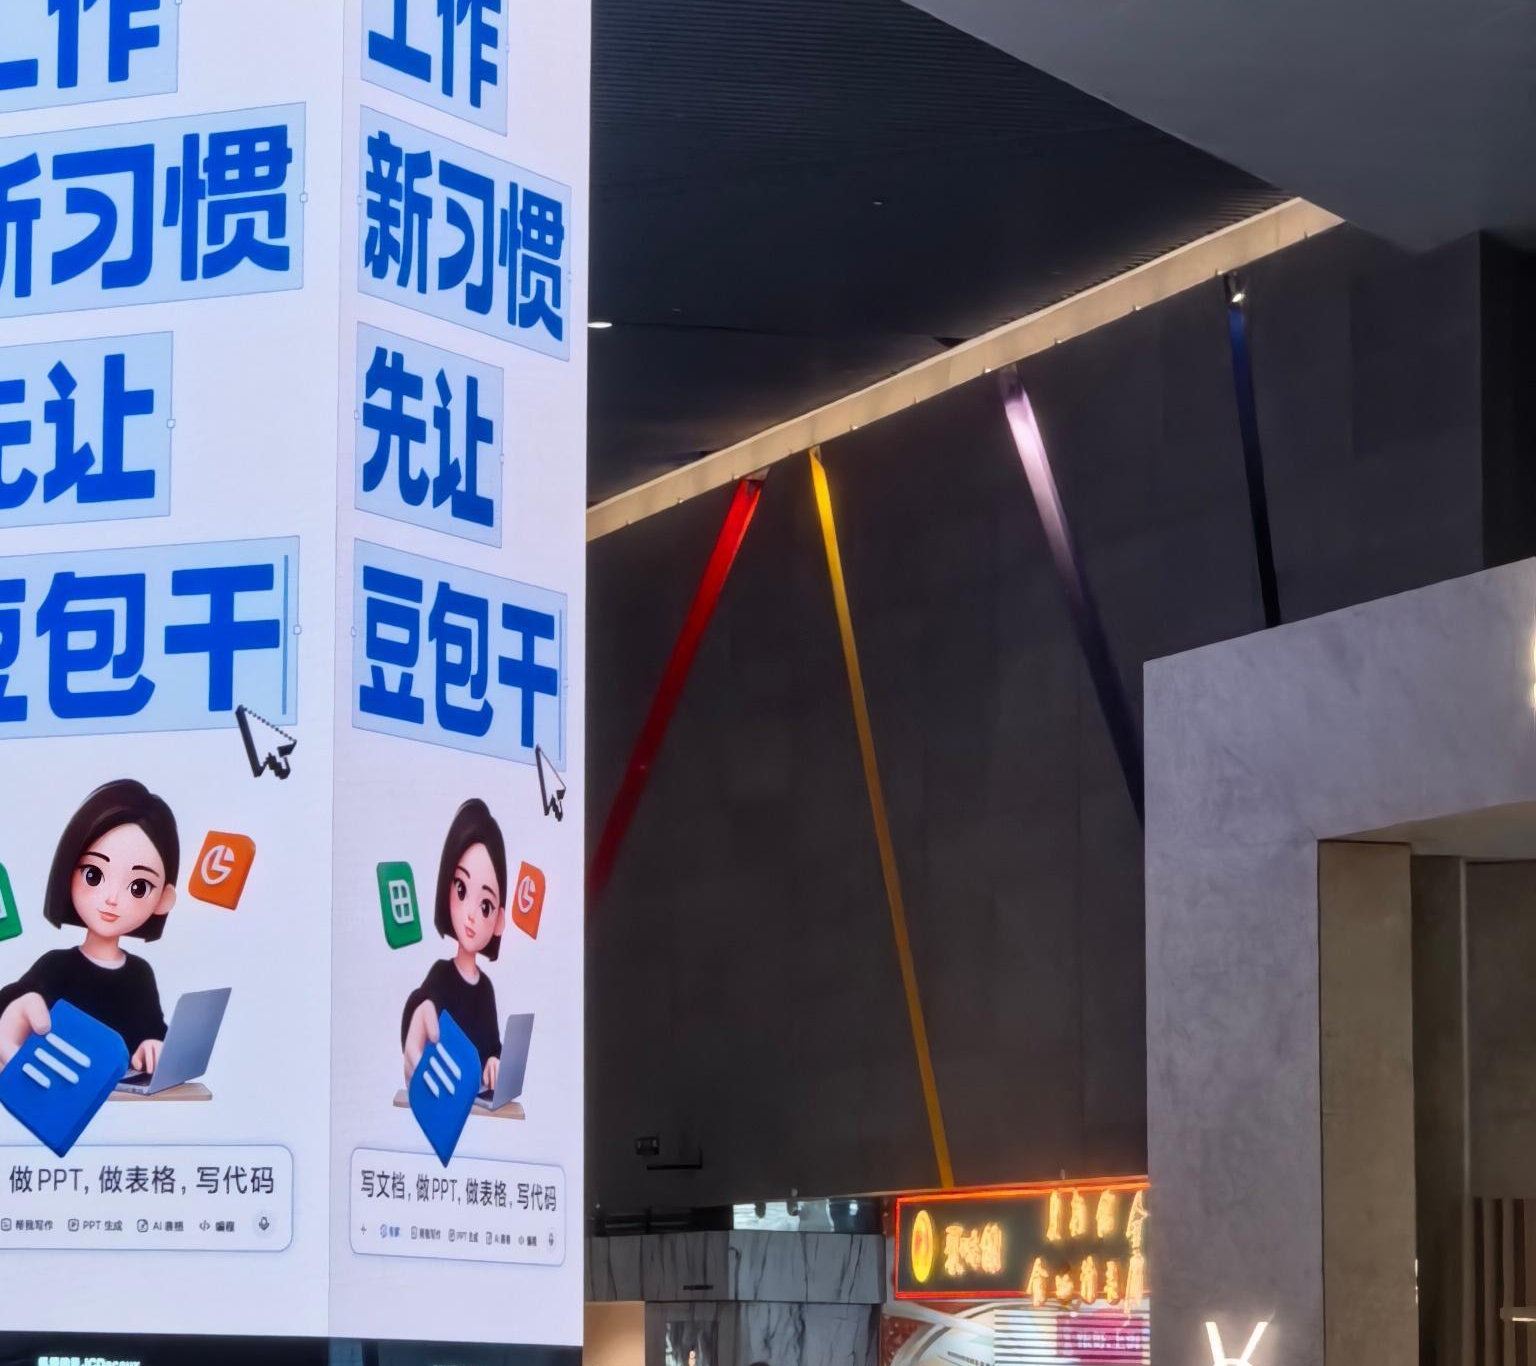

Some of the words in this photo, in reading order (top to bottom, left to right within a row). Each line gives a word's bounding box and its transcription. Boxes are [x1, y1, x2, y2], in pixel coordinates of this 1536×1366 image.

[364, 131, 565, 342] 新习惯
[362, 346, 494, 528] 先让
[359, 565, 558, 750] 豆包干
